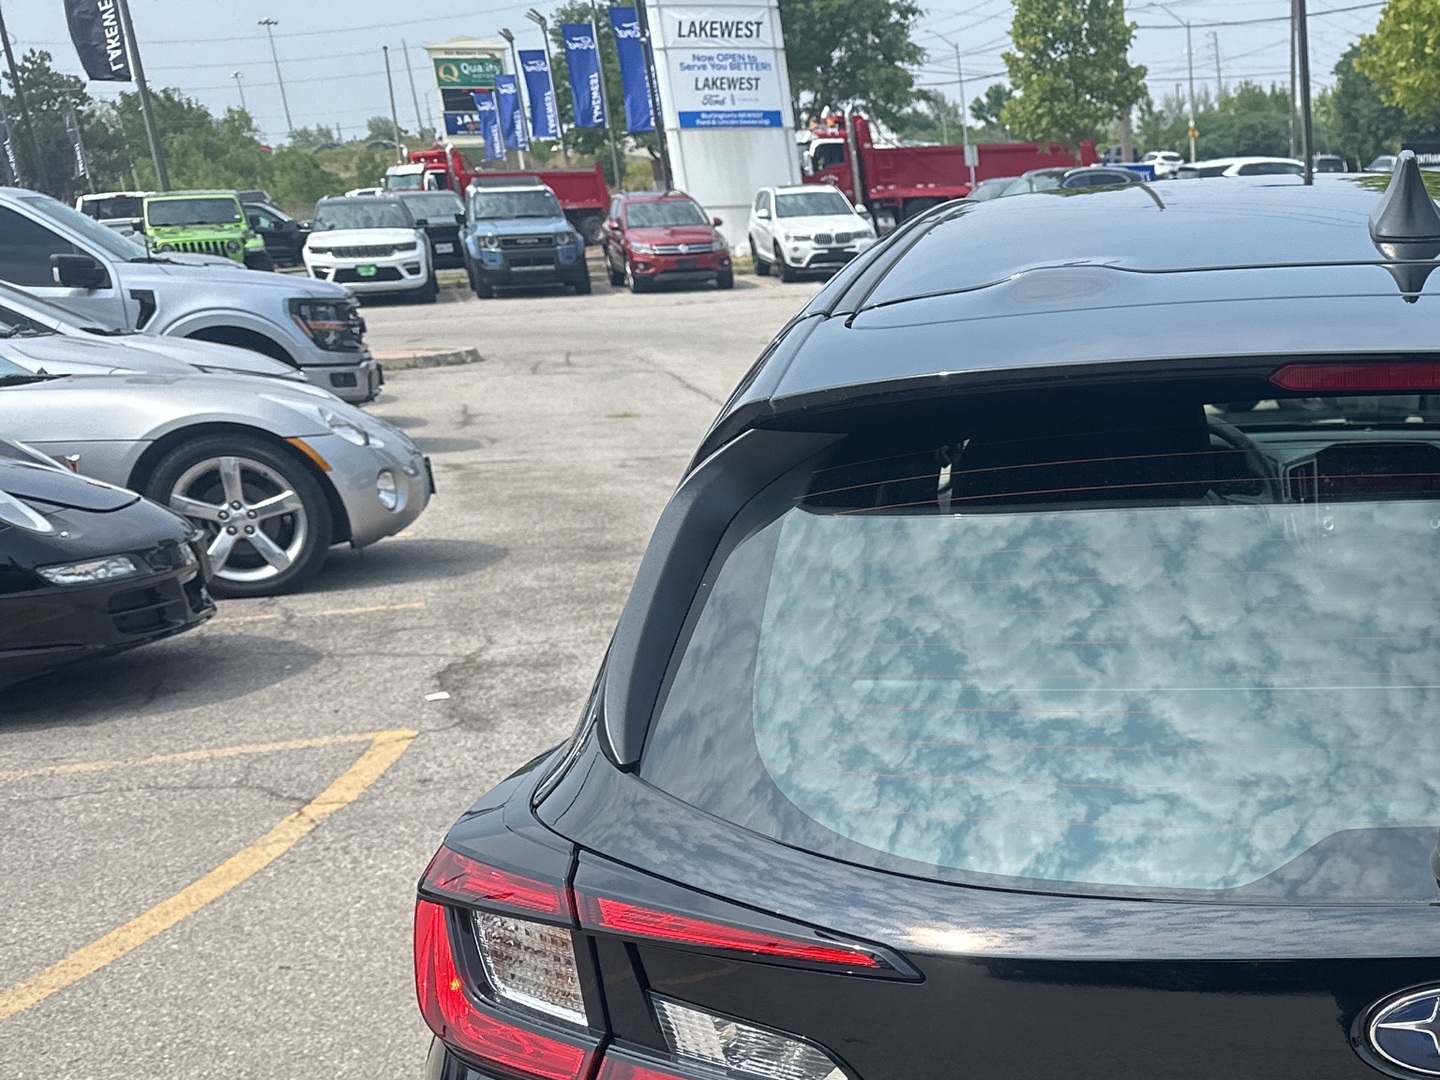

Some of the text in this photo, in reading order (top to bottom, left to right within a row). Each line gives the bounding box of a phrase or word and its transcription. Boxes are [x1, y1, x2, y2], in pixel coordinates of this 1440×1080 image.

[678, 20, 763, 38] LAKEWEST
[692, 53, 758, 62] Now OPEN to
[679, 62, 771, 71] Serve You BETTER!
[694, 77, 761, 91] LAKEWEST
